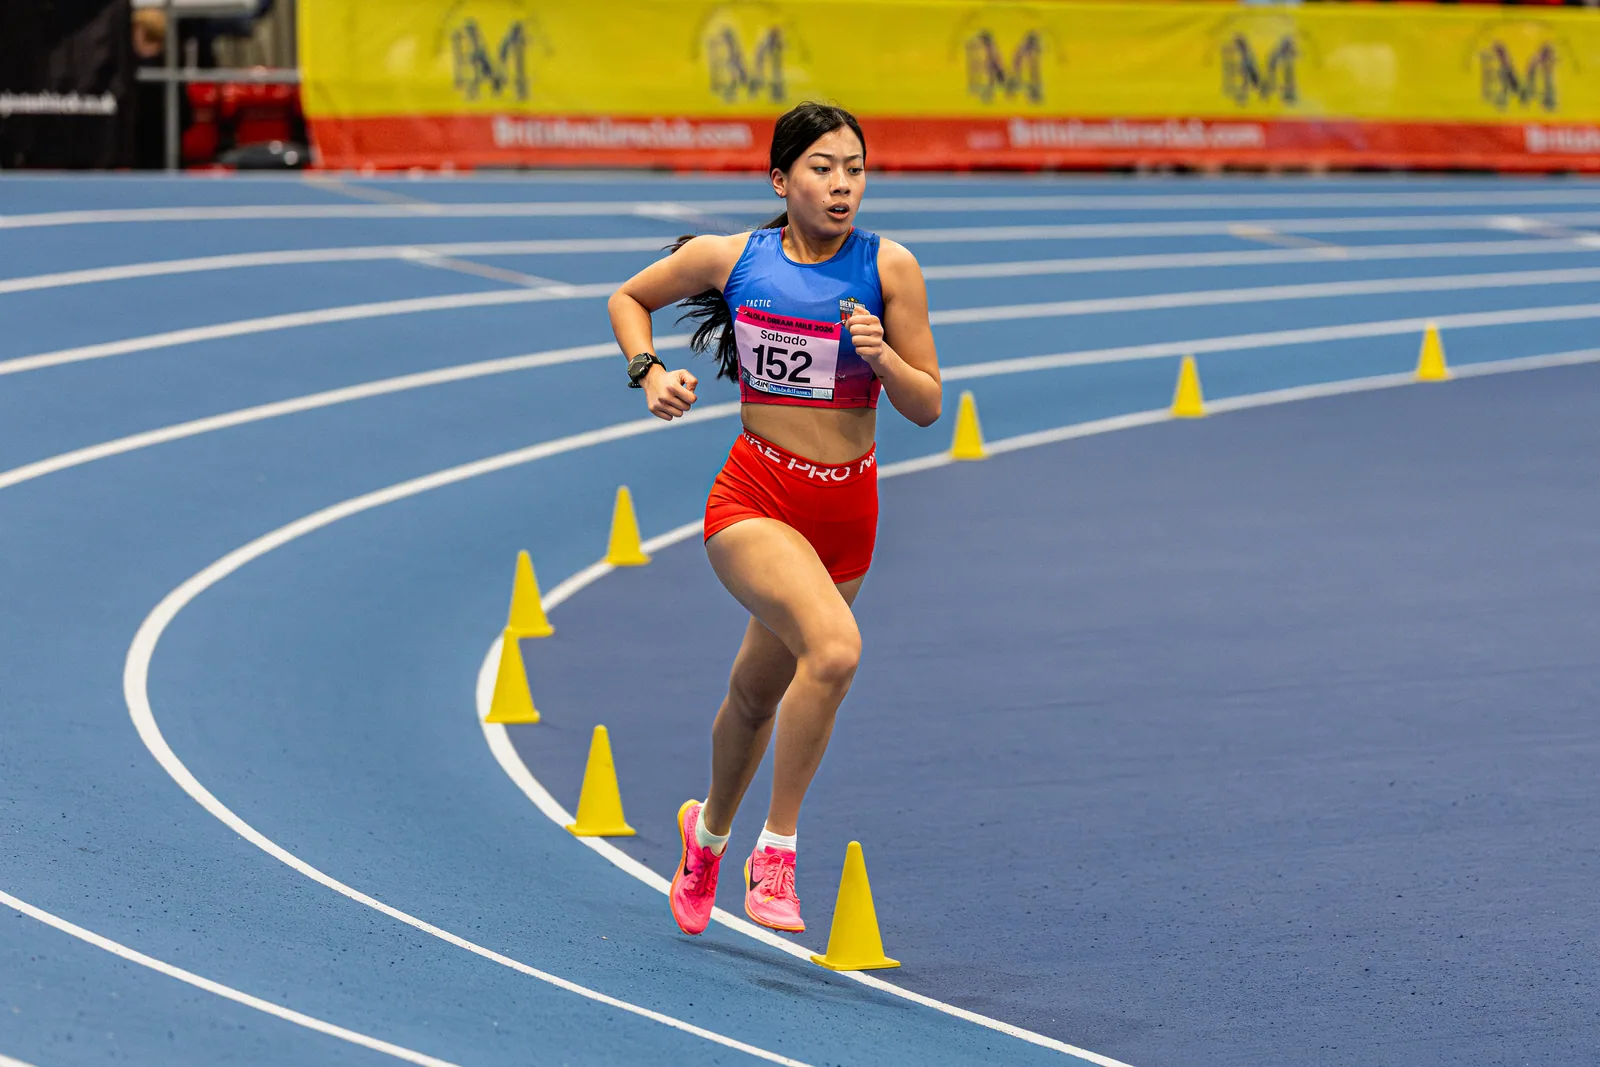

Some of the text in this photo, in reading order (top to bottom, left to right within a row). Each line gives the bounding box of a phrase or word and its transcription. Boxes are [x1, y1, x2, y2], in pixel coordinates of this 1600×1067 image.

[745, 299, 772, 308] TACTIC
[767, 316, 794, 328] DREAM
[795, 321, 812, 331] MILE
[814, 324, 834, 333] 2026
[760, 329, 807, 347] Sabado
[752, 344, 813, 384] 152
[787, 457, 850, 482] PRO
